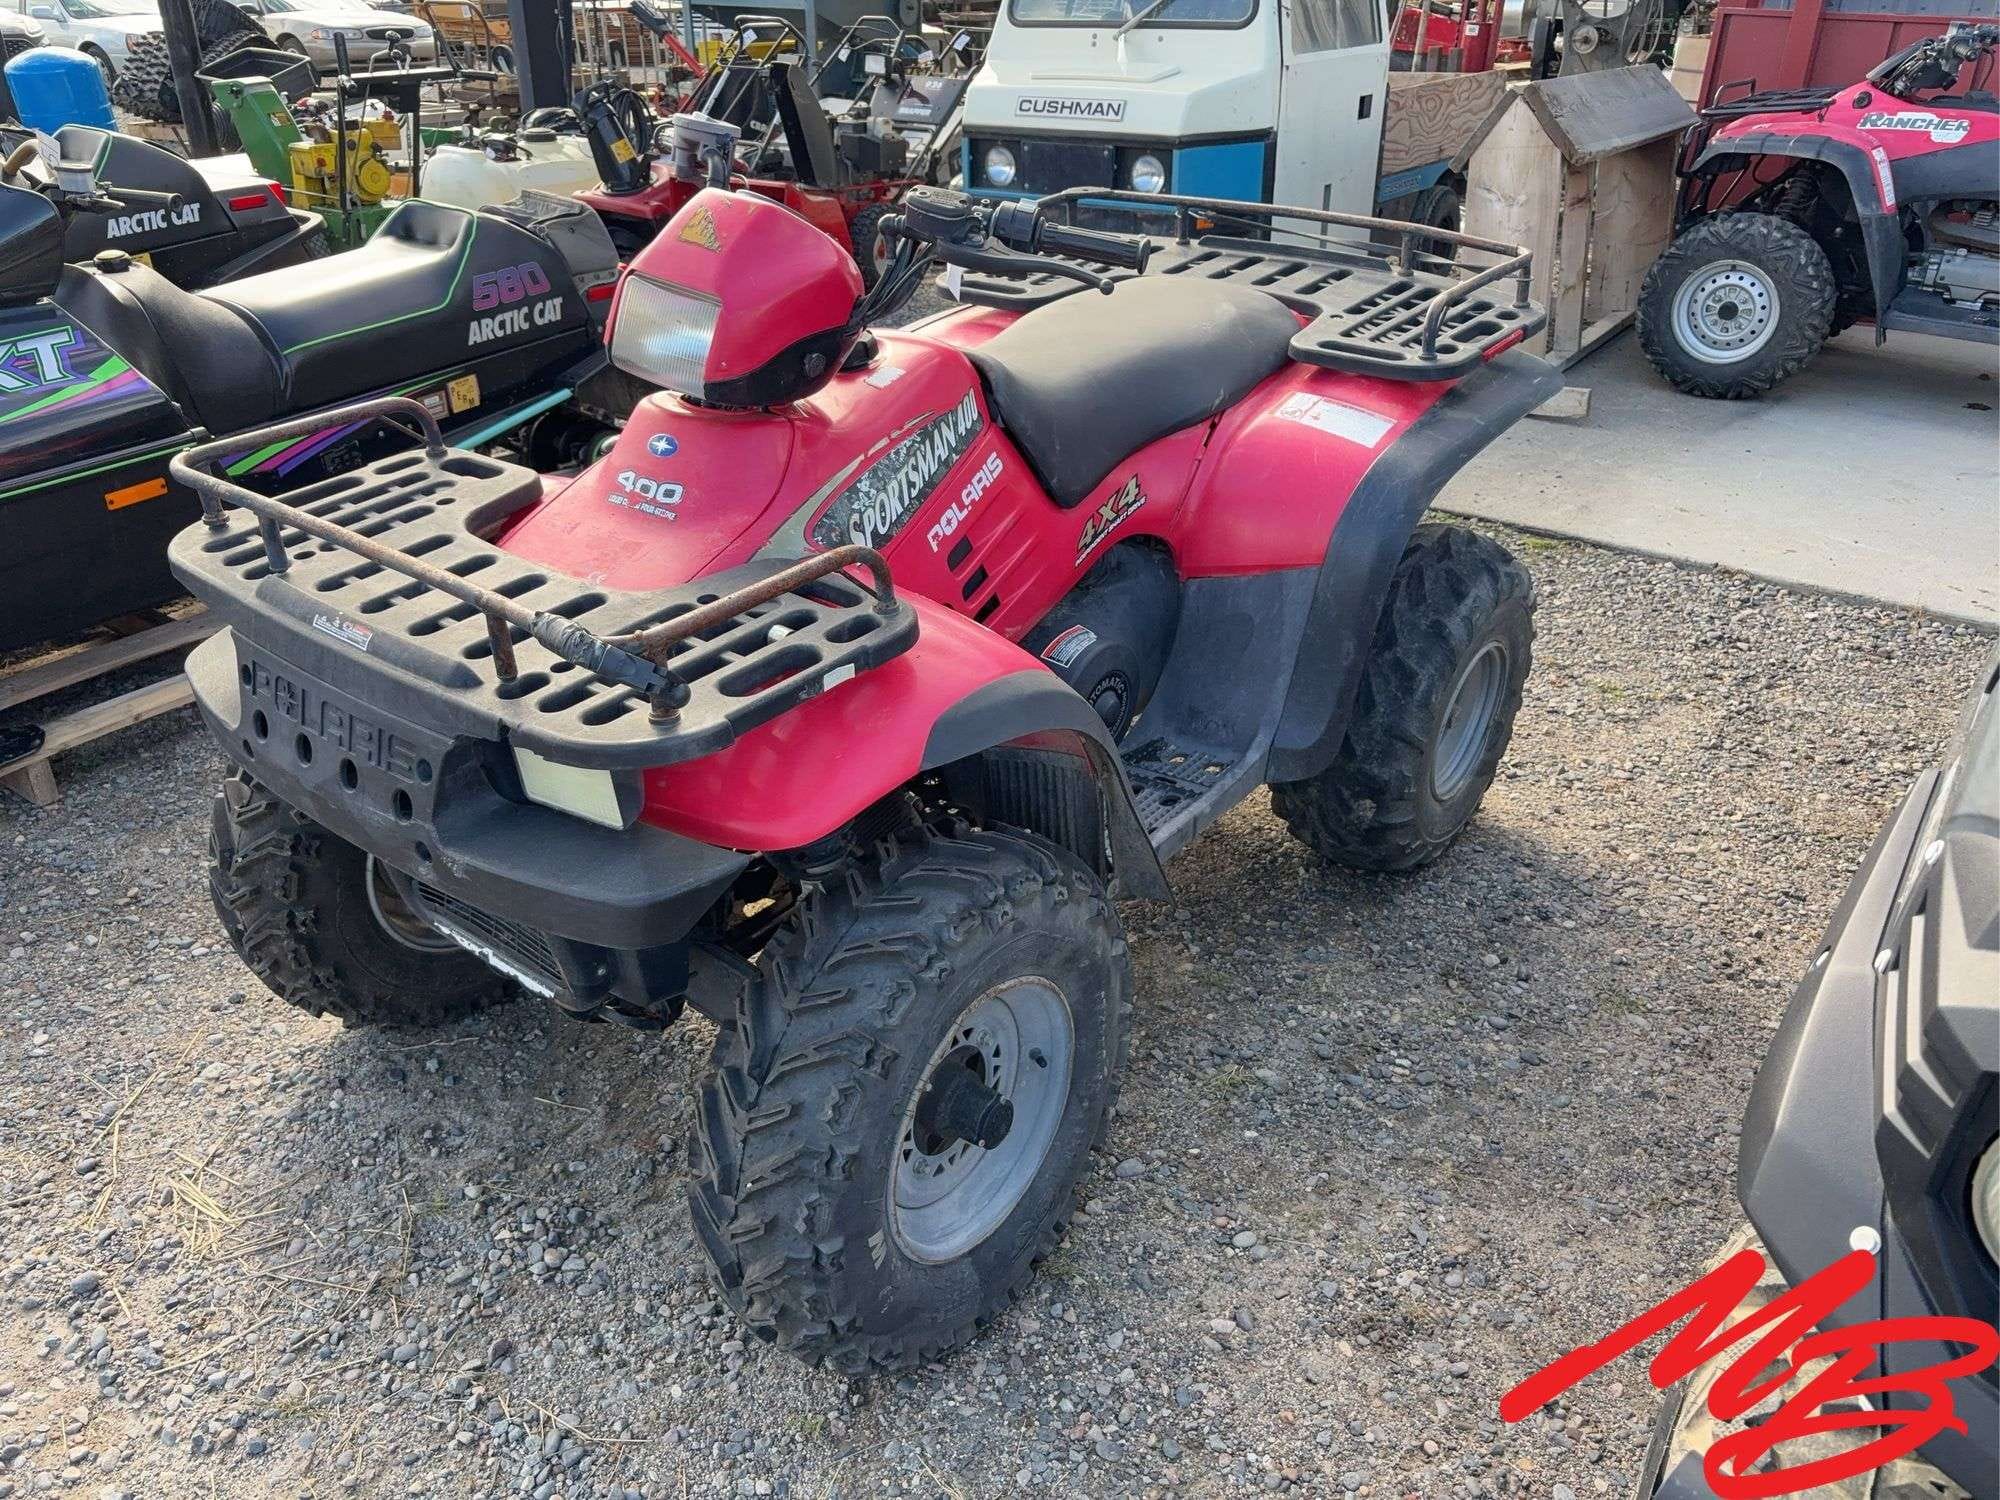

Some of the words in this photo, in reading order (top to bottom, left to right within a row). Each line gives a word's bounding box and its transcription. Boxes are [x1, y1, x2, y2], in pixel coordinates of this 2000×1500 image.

[1018, 99, 1122, 117] CUSHMAN
[1859, 112, 1969, 132] RANCHER
[107, 208, 168, 239] ARCTIC
[171, 202, 201, 226] CAT
[473, 261, 551, 311] 580
[468, 306, 530, 346] ARCTIC
[533, 296, 563, 326] CAT
[616, 469, 685, 504] 400
[849, 410, 957, 549] SPORTSMAN
[957, 387, 979, 437] 400
[926, 451, 1004, 553] POLARIS
[252, 659, 415, 784] POLARIS
